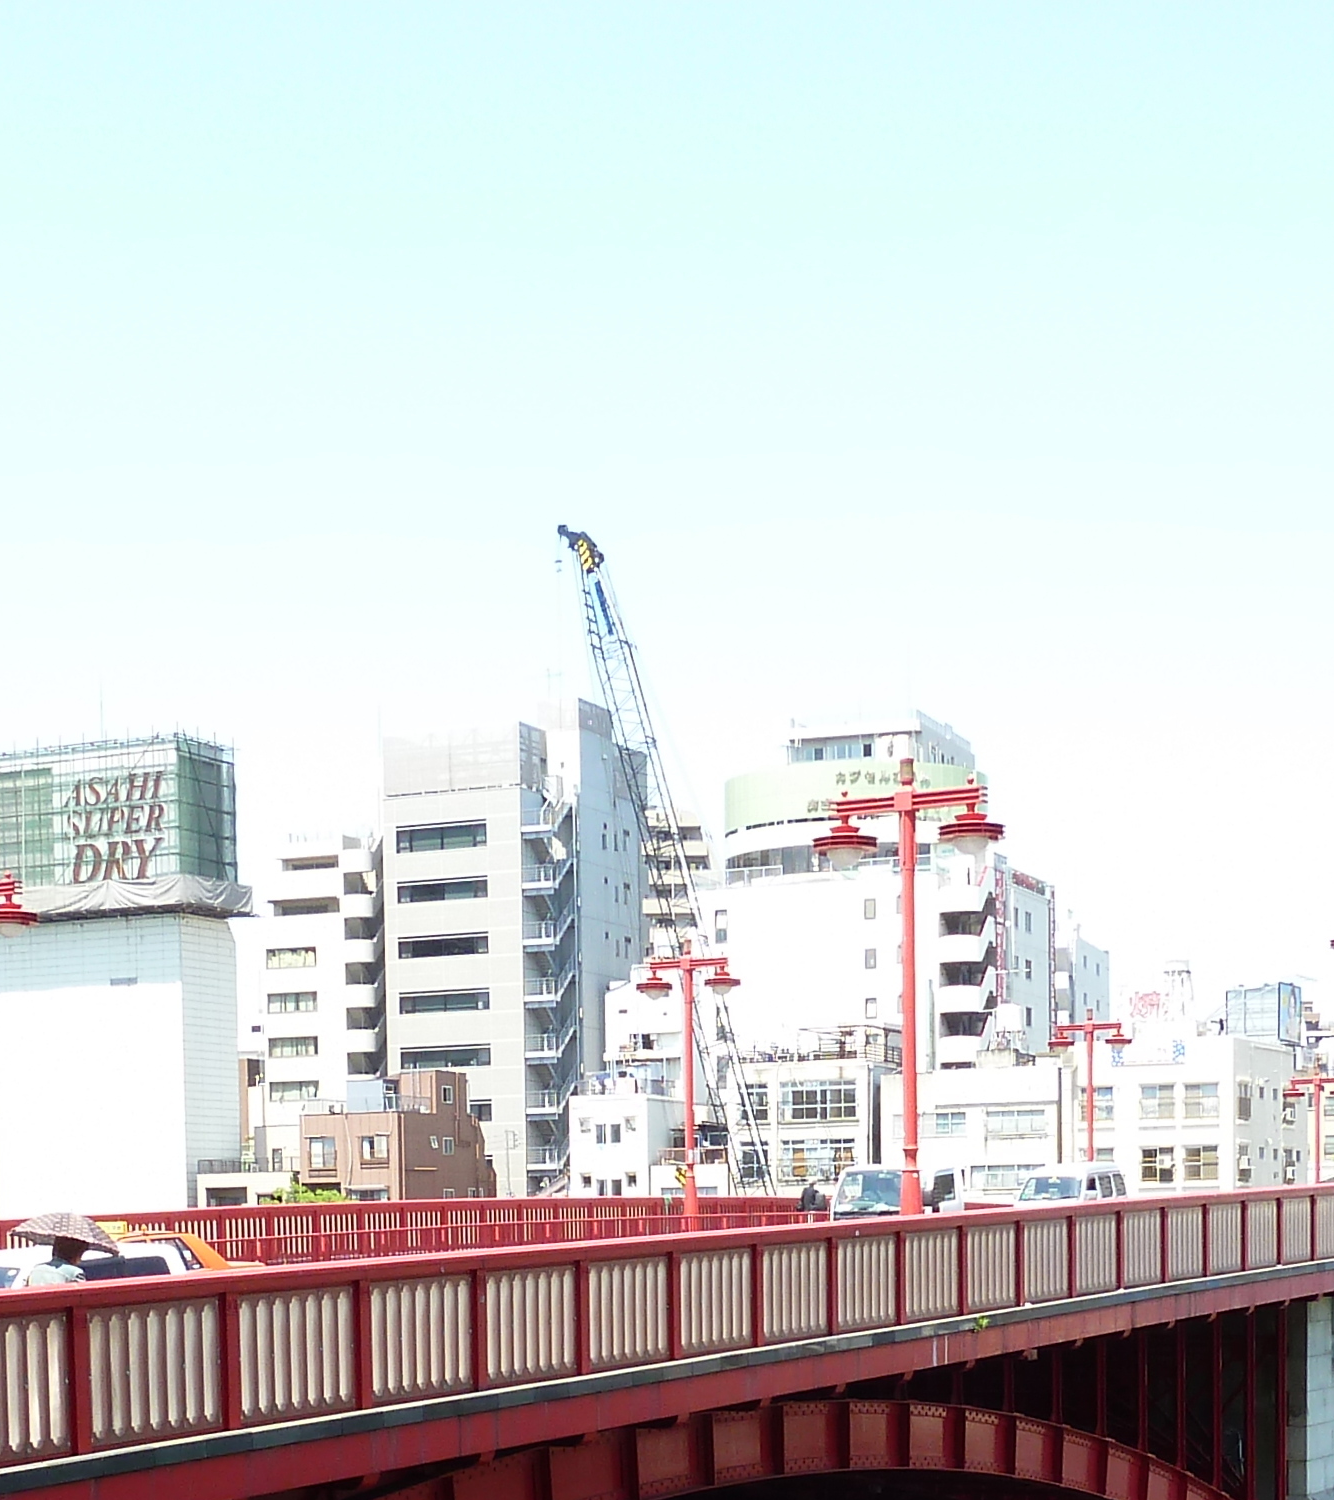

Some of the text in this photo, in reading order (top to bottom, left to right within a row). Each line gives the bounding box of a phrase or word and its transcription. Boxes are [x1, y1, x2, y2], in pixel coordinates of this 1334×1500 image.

[64, 770, 164, 808] ASAHI
[67, 803, 165, 838] SUPER
[72, 836, 163, 885] DRY
